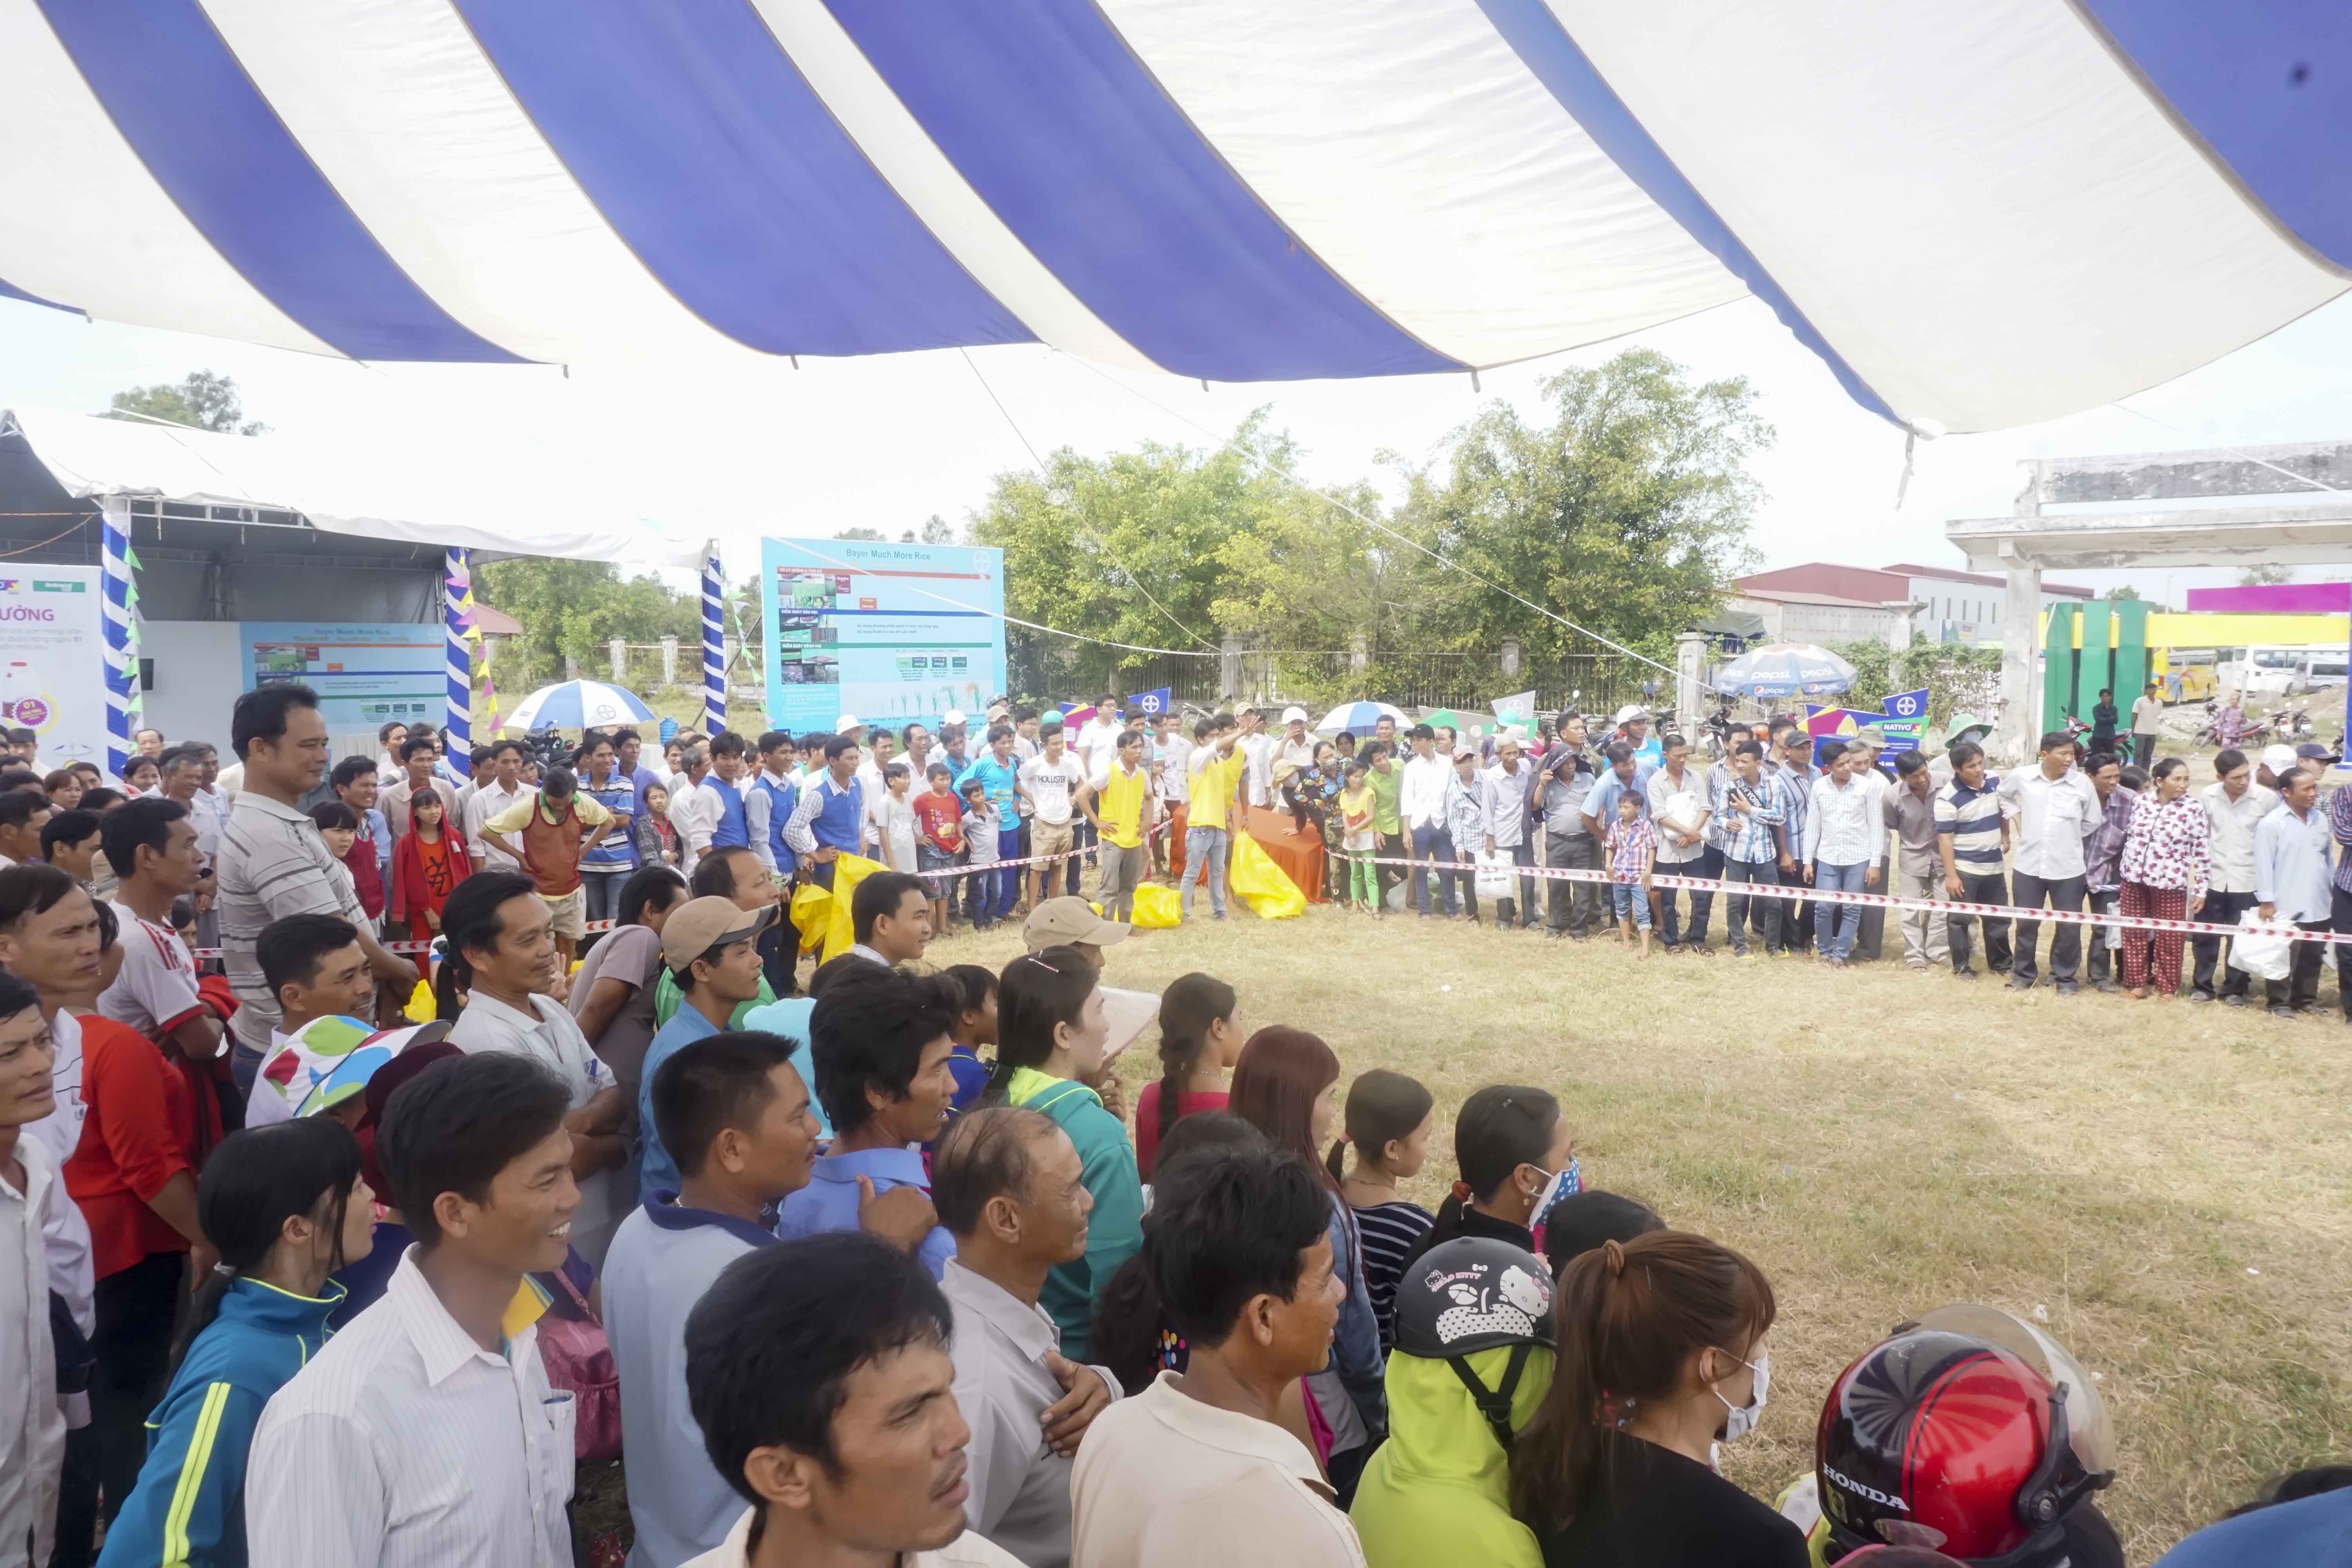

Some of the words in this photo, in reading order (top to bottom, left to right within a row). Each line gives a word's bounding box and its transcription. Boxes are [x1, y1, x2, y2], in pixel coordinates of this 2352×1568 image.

[846, 549, 869, 559] Bayer
[871, 550, 891, 559] Much
[894, 551, 912, 559] More
[1751, 670, 1791, 681] pepsi
[1800, 666, 1836, 679] pepsi
[1038, 775, 1066, 783] HOLLISTER
[1823, 1462, 1911, 1512] HONDA
